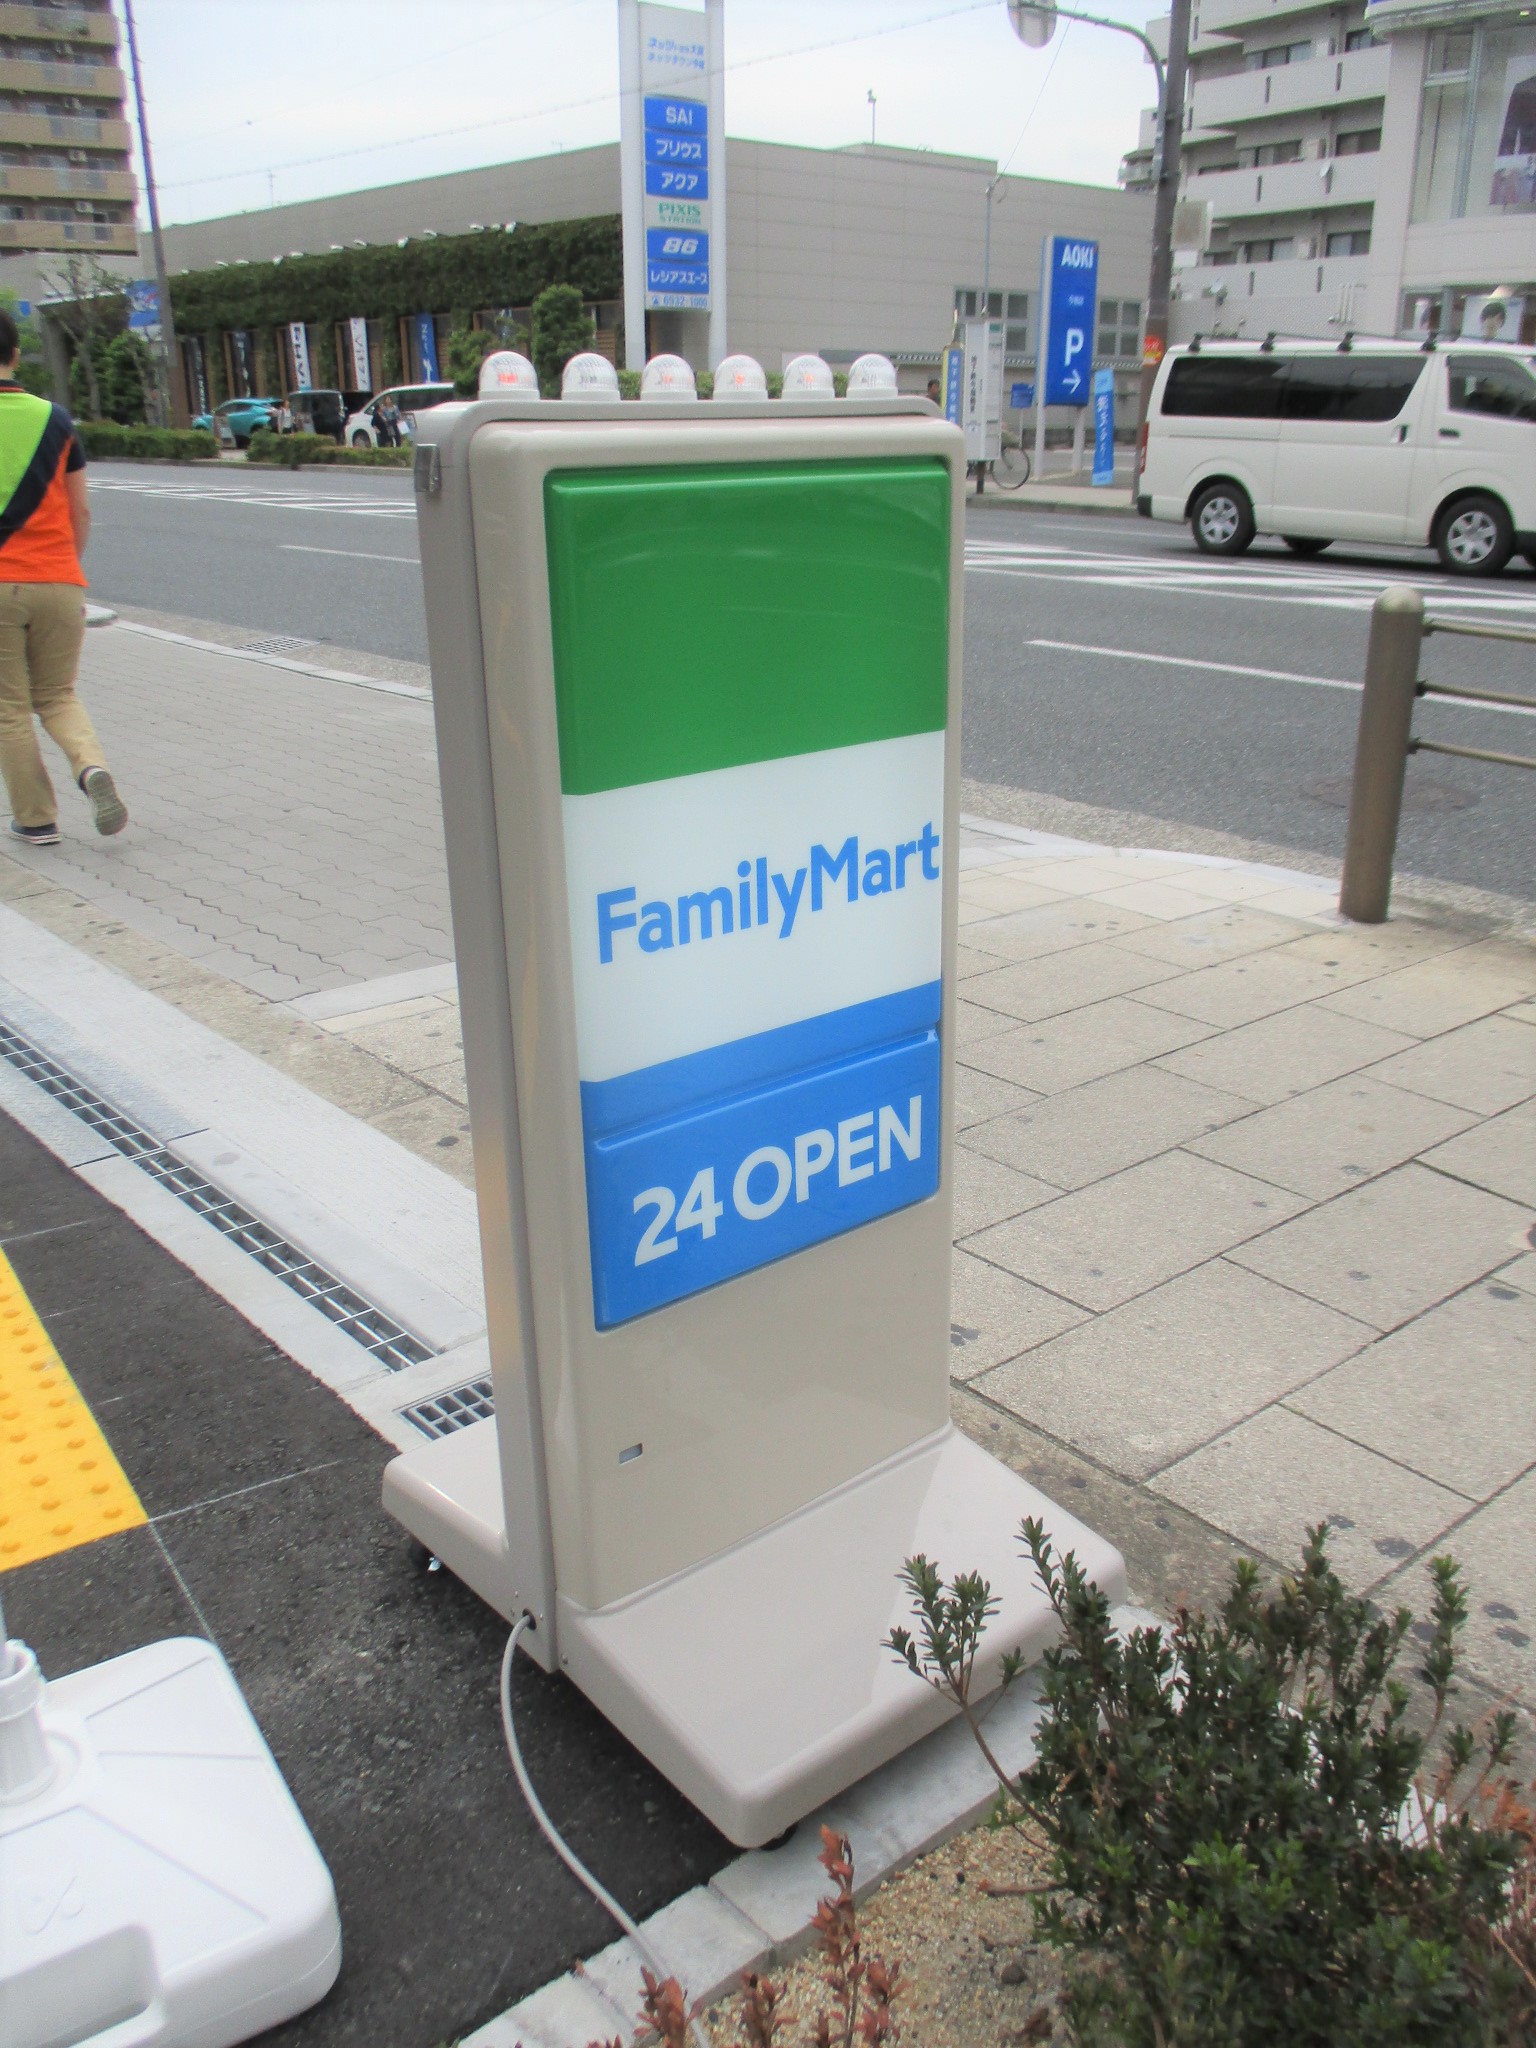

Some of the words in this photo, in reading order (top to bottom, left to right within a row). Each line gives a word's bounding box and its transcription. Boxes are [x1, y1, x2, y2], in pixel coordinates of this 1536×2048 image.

[666, 106, 693, 126] SAI
[656, 138, 702, 159] プリウス
[661, 171, 698, 191] アクア
[658, 202, 701, 216] PIXIS
[662, 237, 699, 255] 86
[1061, 244, 1094, 269] AOKI
[1064, 328, 1085, 367] P
[596, 821, 940, 964] FamilyMart
[633, 1167, 723, 1267] 24
[732, 1094, 922, 1221] OPEN
